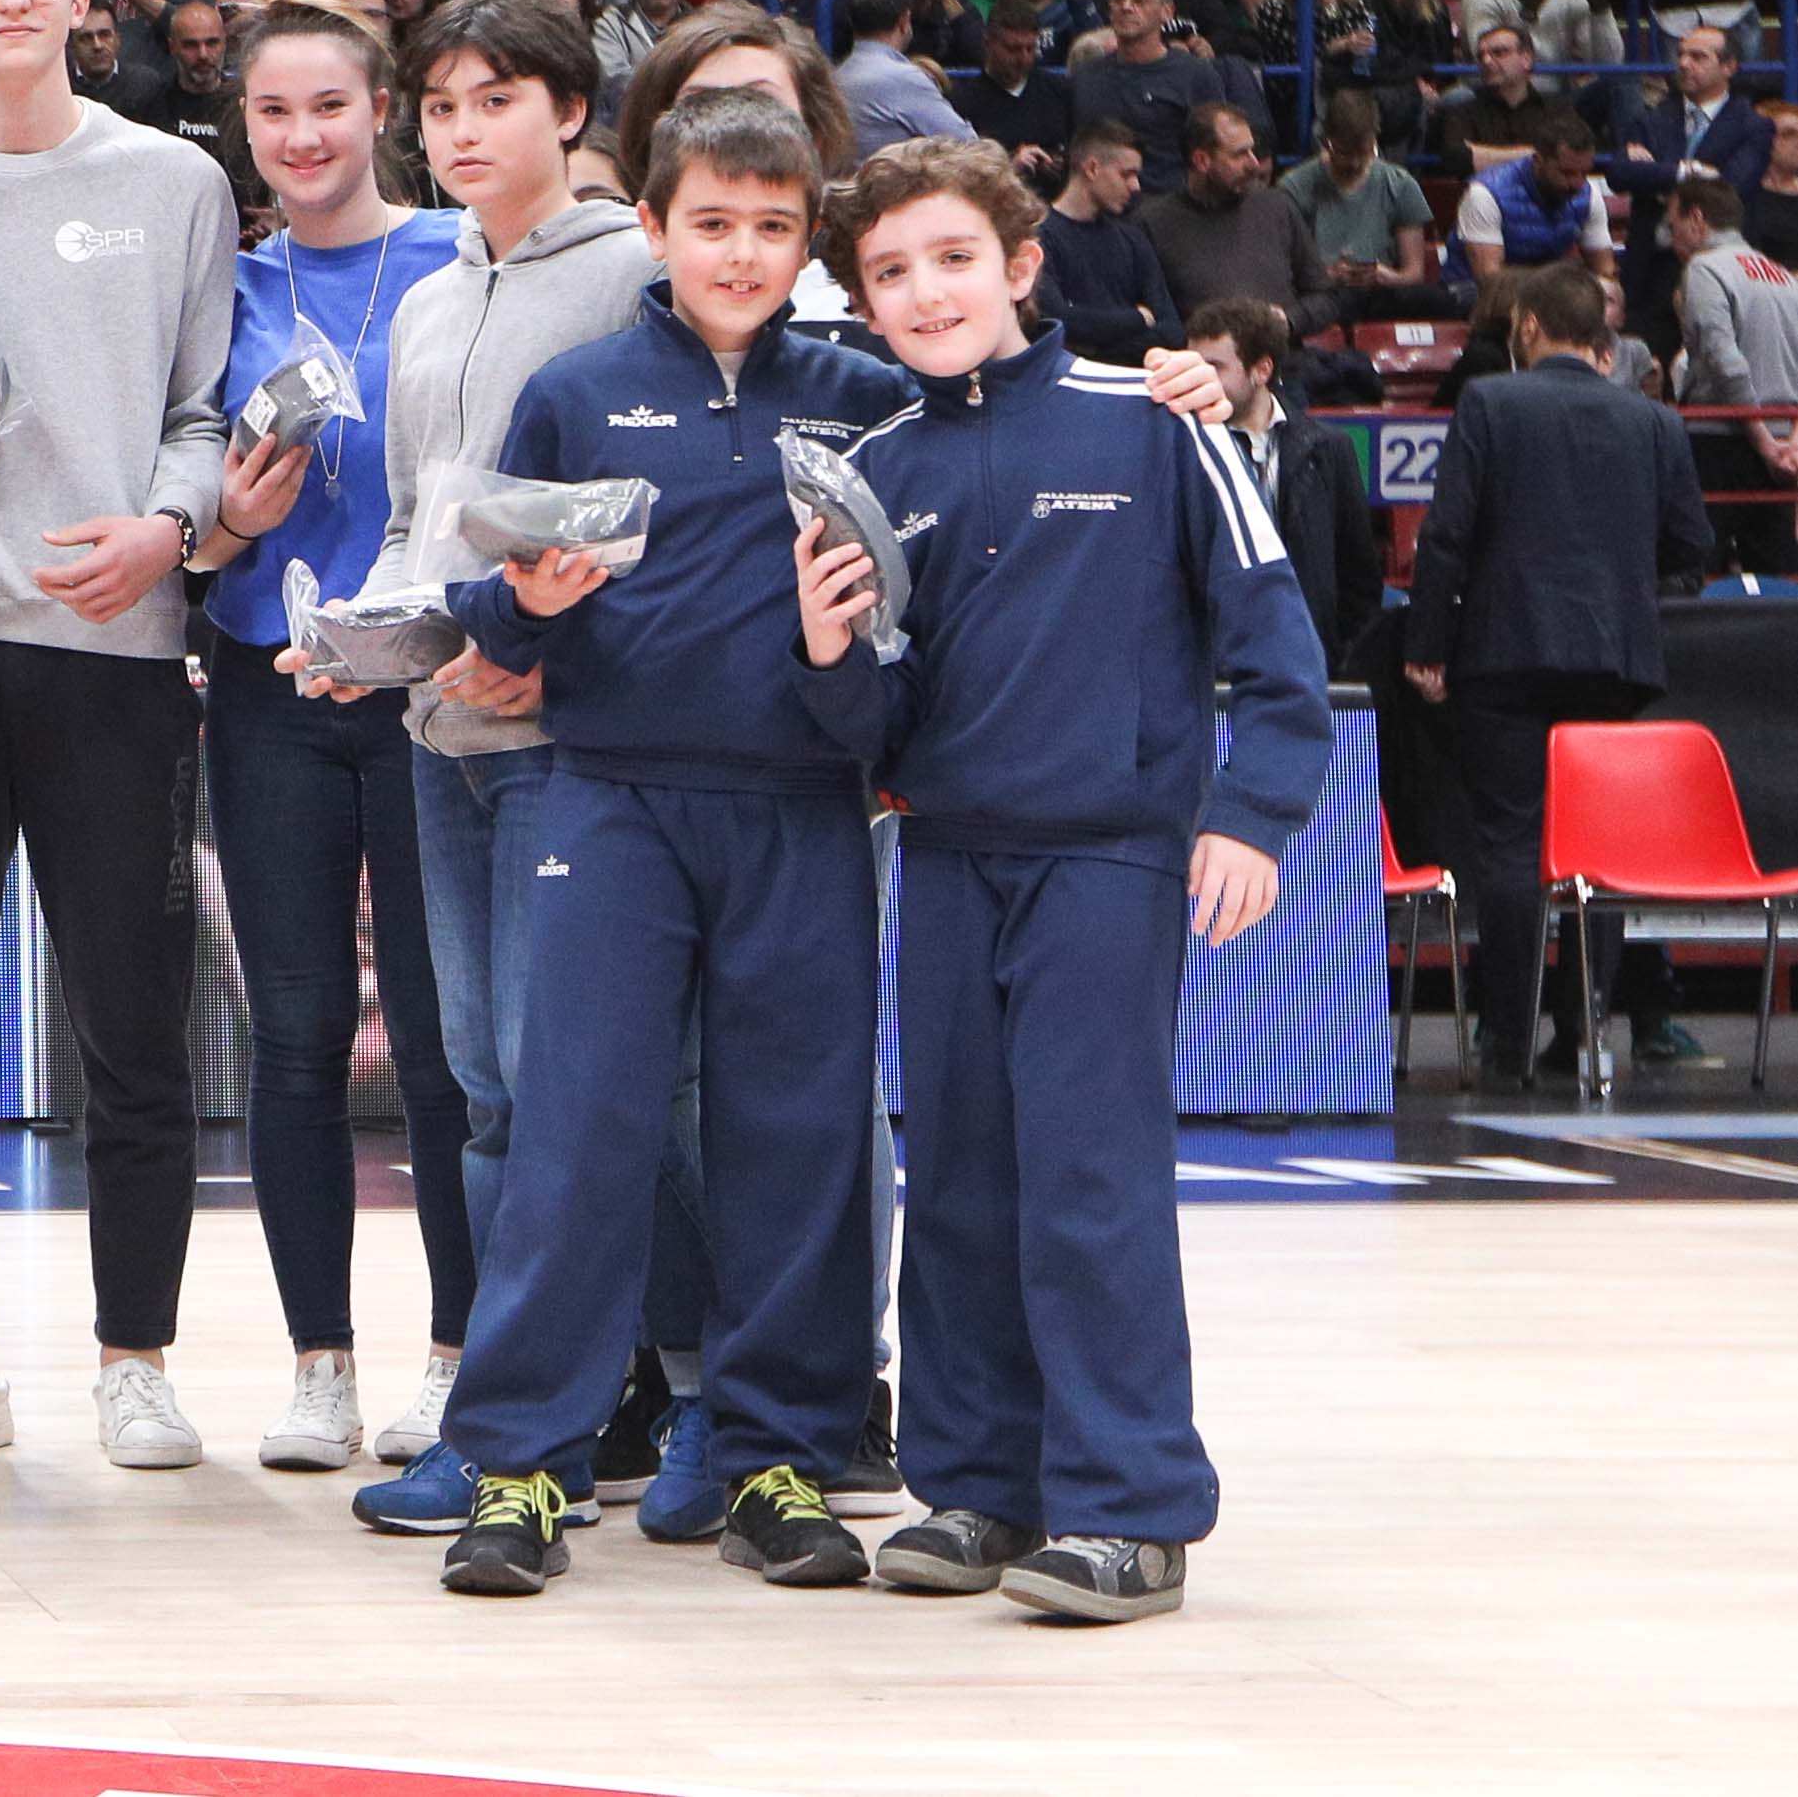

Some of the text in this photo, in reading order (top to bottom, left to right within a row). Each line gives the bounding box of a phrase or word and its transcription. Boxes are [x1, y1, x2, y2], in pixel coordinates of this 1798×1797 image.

[85, 228, 145, 250] SPR
[1408, 326, 1423, 343] 11
[606, 414, 679, 428] REXER
[796, 424, 851, 440] ATENA
[1384, 437, 1446, 485] 22
[1050, 500, 1117, 511] ATENA
